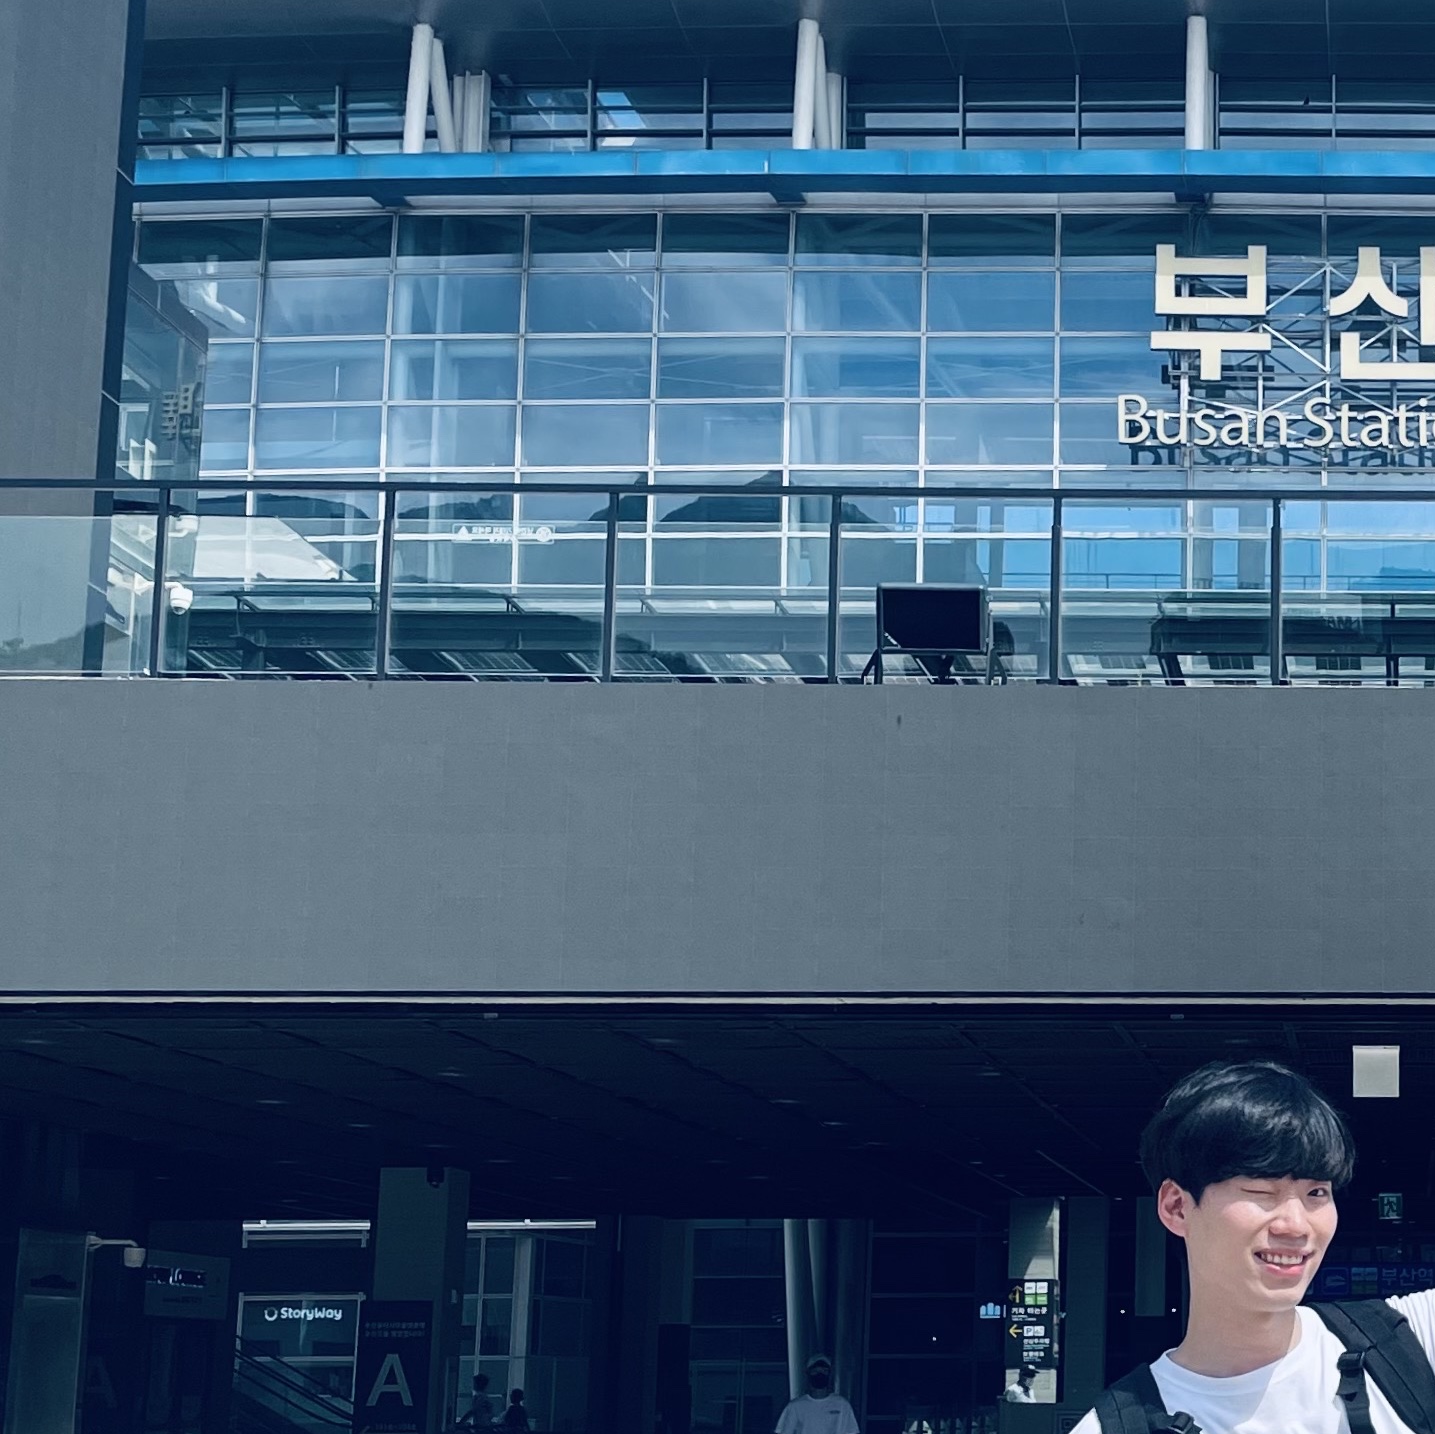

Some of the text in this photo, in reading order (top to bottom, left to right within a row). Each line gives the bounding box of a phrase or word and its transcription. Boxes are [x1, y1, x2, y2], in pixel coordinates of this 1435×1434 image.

[1117, 394, 1288, 447] Busan
[1381, 1267, 1434, 1287] 부산역
[280, 1307, 343, 1321] StoryWay
[365, 1353, 414, 1407] A
